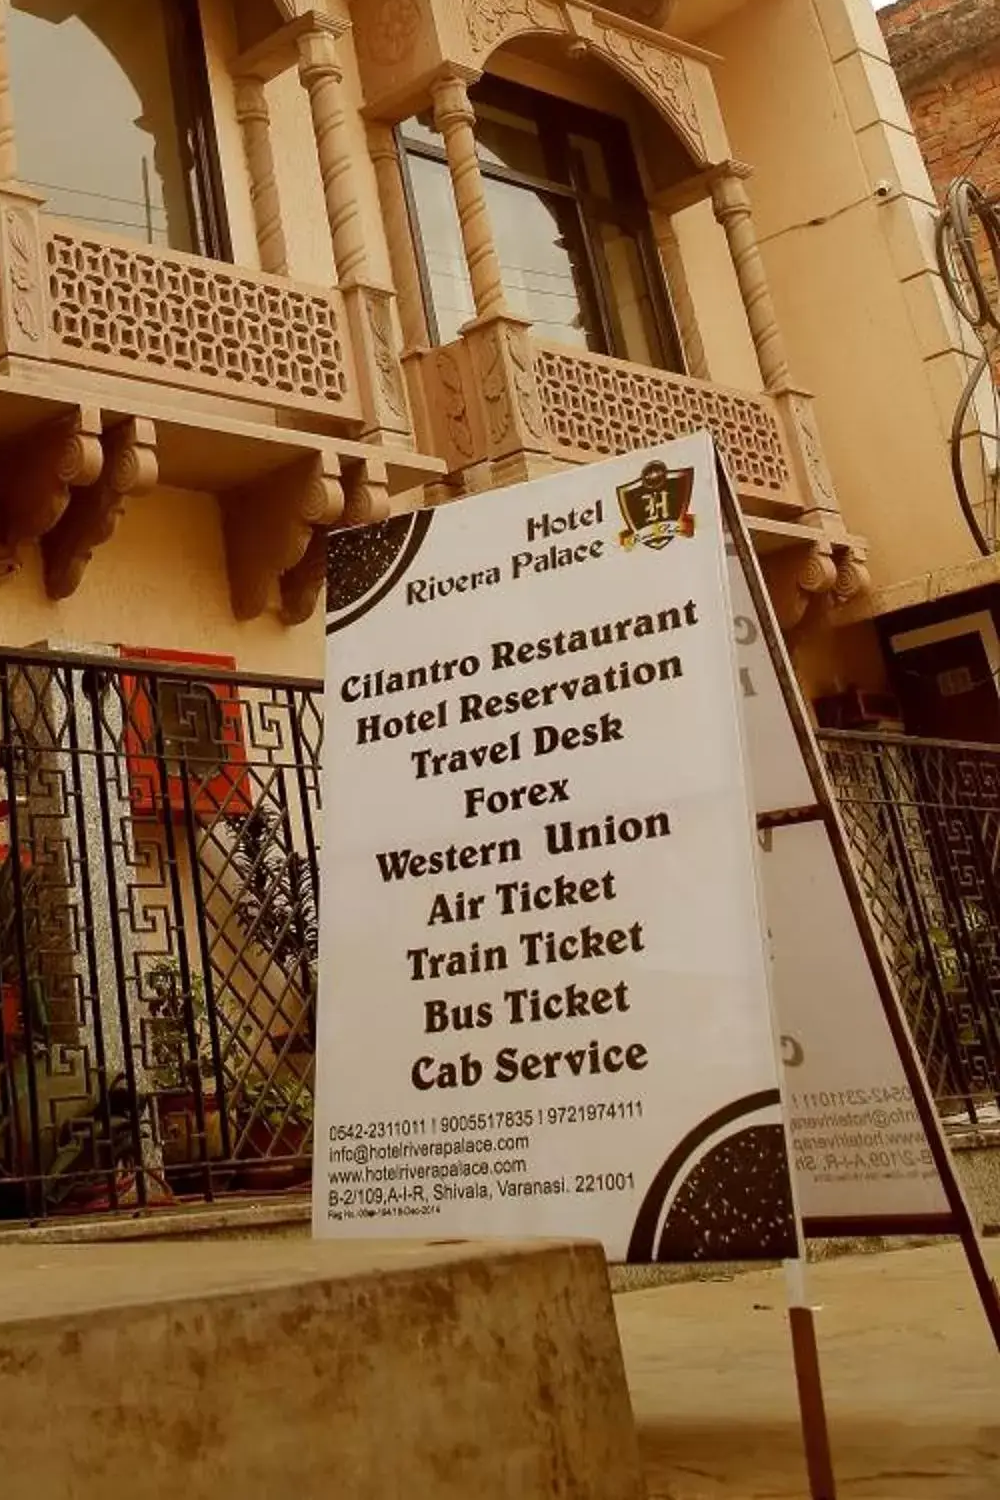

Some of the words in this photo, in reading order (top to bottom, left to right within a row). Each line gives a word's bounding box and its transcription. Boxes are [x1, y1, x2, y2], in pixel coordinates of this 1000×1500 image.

[527, 500, 603, 542] Hotel
[407, 567, 500, 606] Rivera
[512, 538, 604, 579] Palace
[340, 656, 480, 702] Cilantro
[491, 600, 698, 670] Restaurant
[356, 700, 448, 745] Hotel
[459, 656, 683, 724] Reservation
[411, 731, 520, 780] Travel
[533, 713, 624, 756] Desk
[464, 778, 570, 818] Forex
[376, 838, 521, 882] Western
[544, 812, 671, 855] Union
[427, 892, 485, 926] Air
[496, 870, 616, 916] Ticket
[407, 942, 508, 980] Train
[520, 922, 645, 966] Ticket
[424, 1000, 493, 1034] Bus
[504, 980, 630, 1024] Ticket
[412, 1052, 482, 1090] Cab
[494, 1040, 648, 1083] Service
[329, 1119, 426, 1141] 0542-2311011
[440, 1109, 533, 1133] 9005517835
[547, 1100, 643, 1124] 9721974111
[328, 1158, 527, 1184] www.hotelriverapalace.com
[329, 1135, 529, 1164] info@hotelriverapalace.com
[433, 1181, 493, 1201] Shivala,
[575, 1172, 634, 1193] 221001
